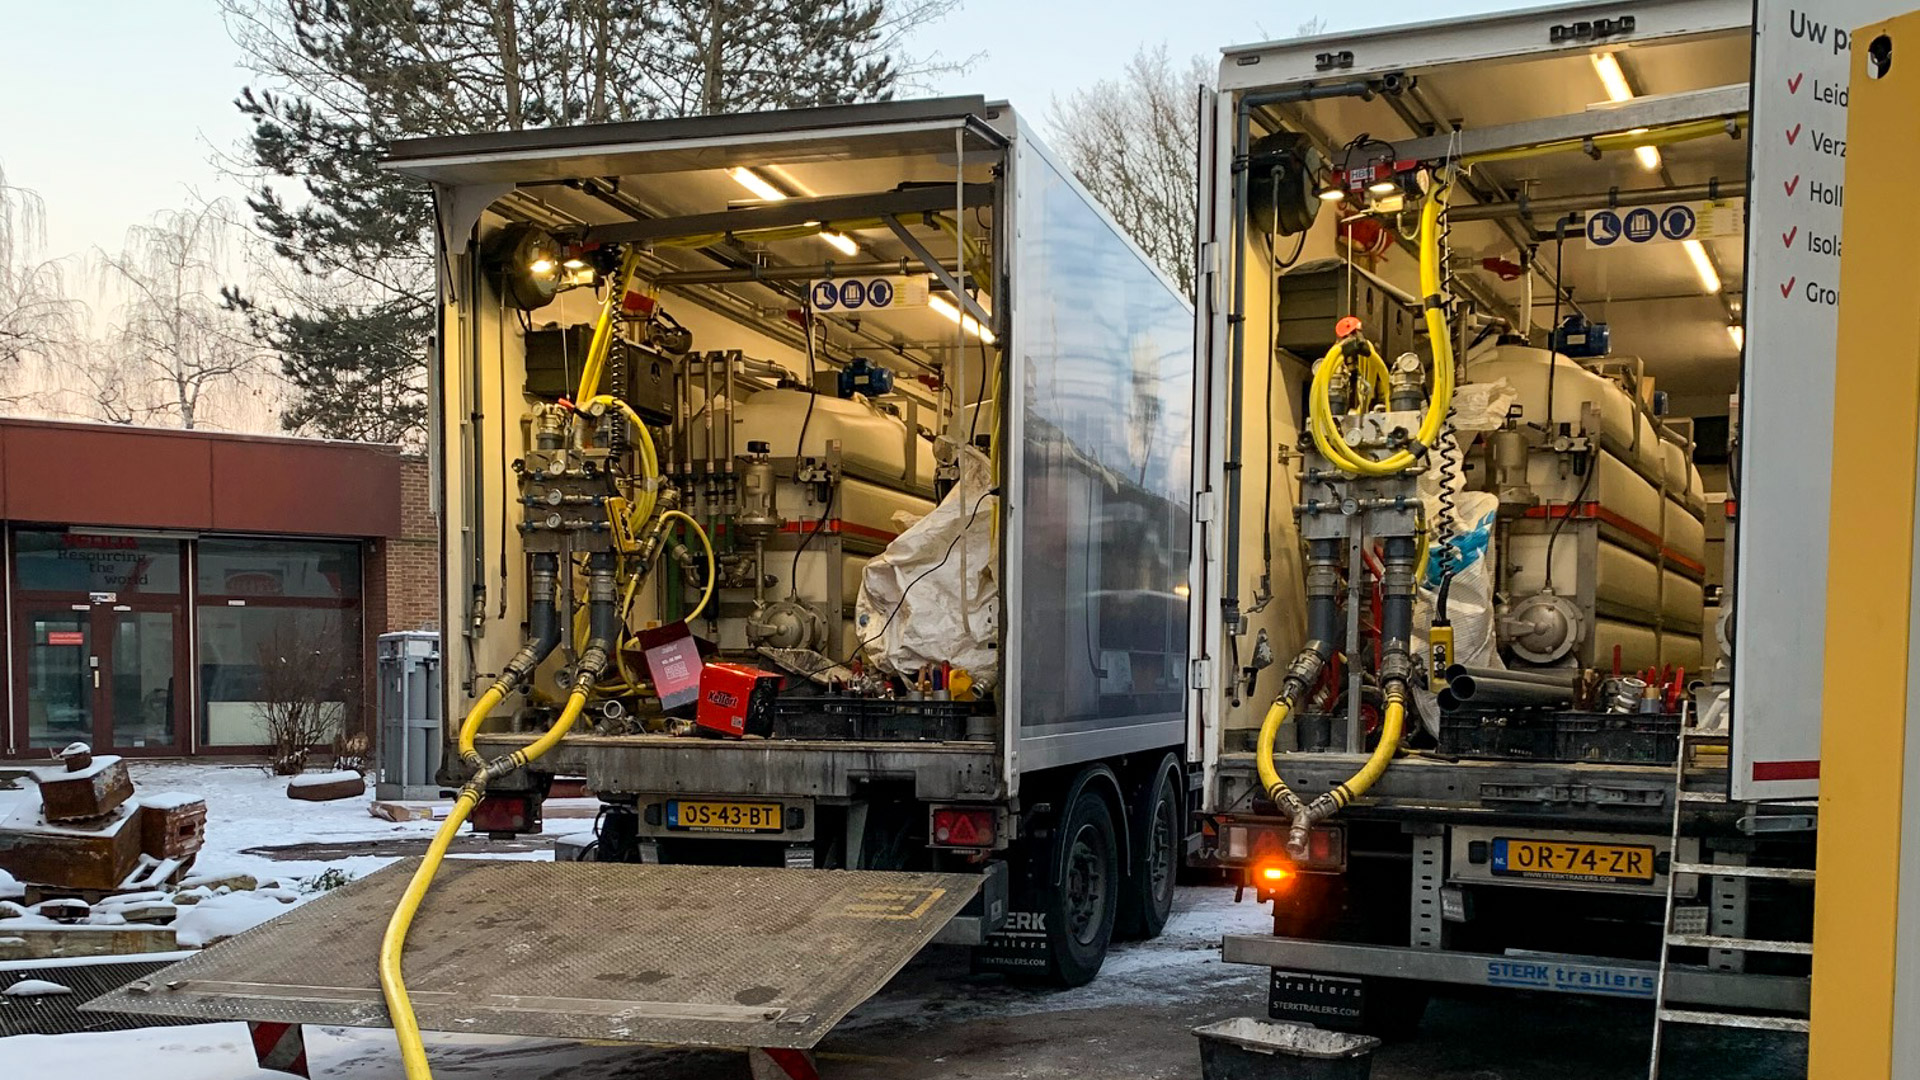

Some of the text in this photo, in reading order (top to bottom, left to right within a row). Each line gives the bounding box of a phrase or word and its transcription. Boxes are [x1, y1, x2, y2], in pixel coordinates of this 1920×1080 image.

[1790, 9, 1827, 44] Uw
[1813, 79, 1849, 108] Leid
[1811, 129, 1846, 158] Verz
[1810, 180, 1843, 207] Holl
[57, 548, 146, 567] Resourcing
[90, 562, 115, 574] the
[685, 805, 773, 825] OS-43-BT
[1495, 857, 1506, 865] NL
[1518, 845, 1642, 873] OR-74-ZR
[1487, 962, 1654, 988] STERK trailers
[1275, 980, 1361, 997] trailers
[1273, 1001, 1360, 1016] STERKTRAILERS.COM
